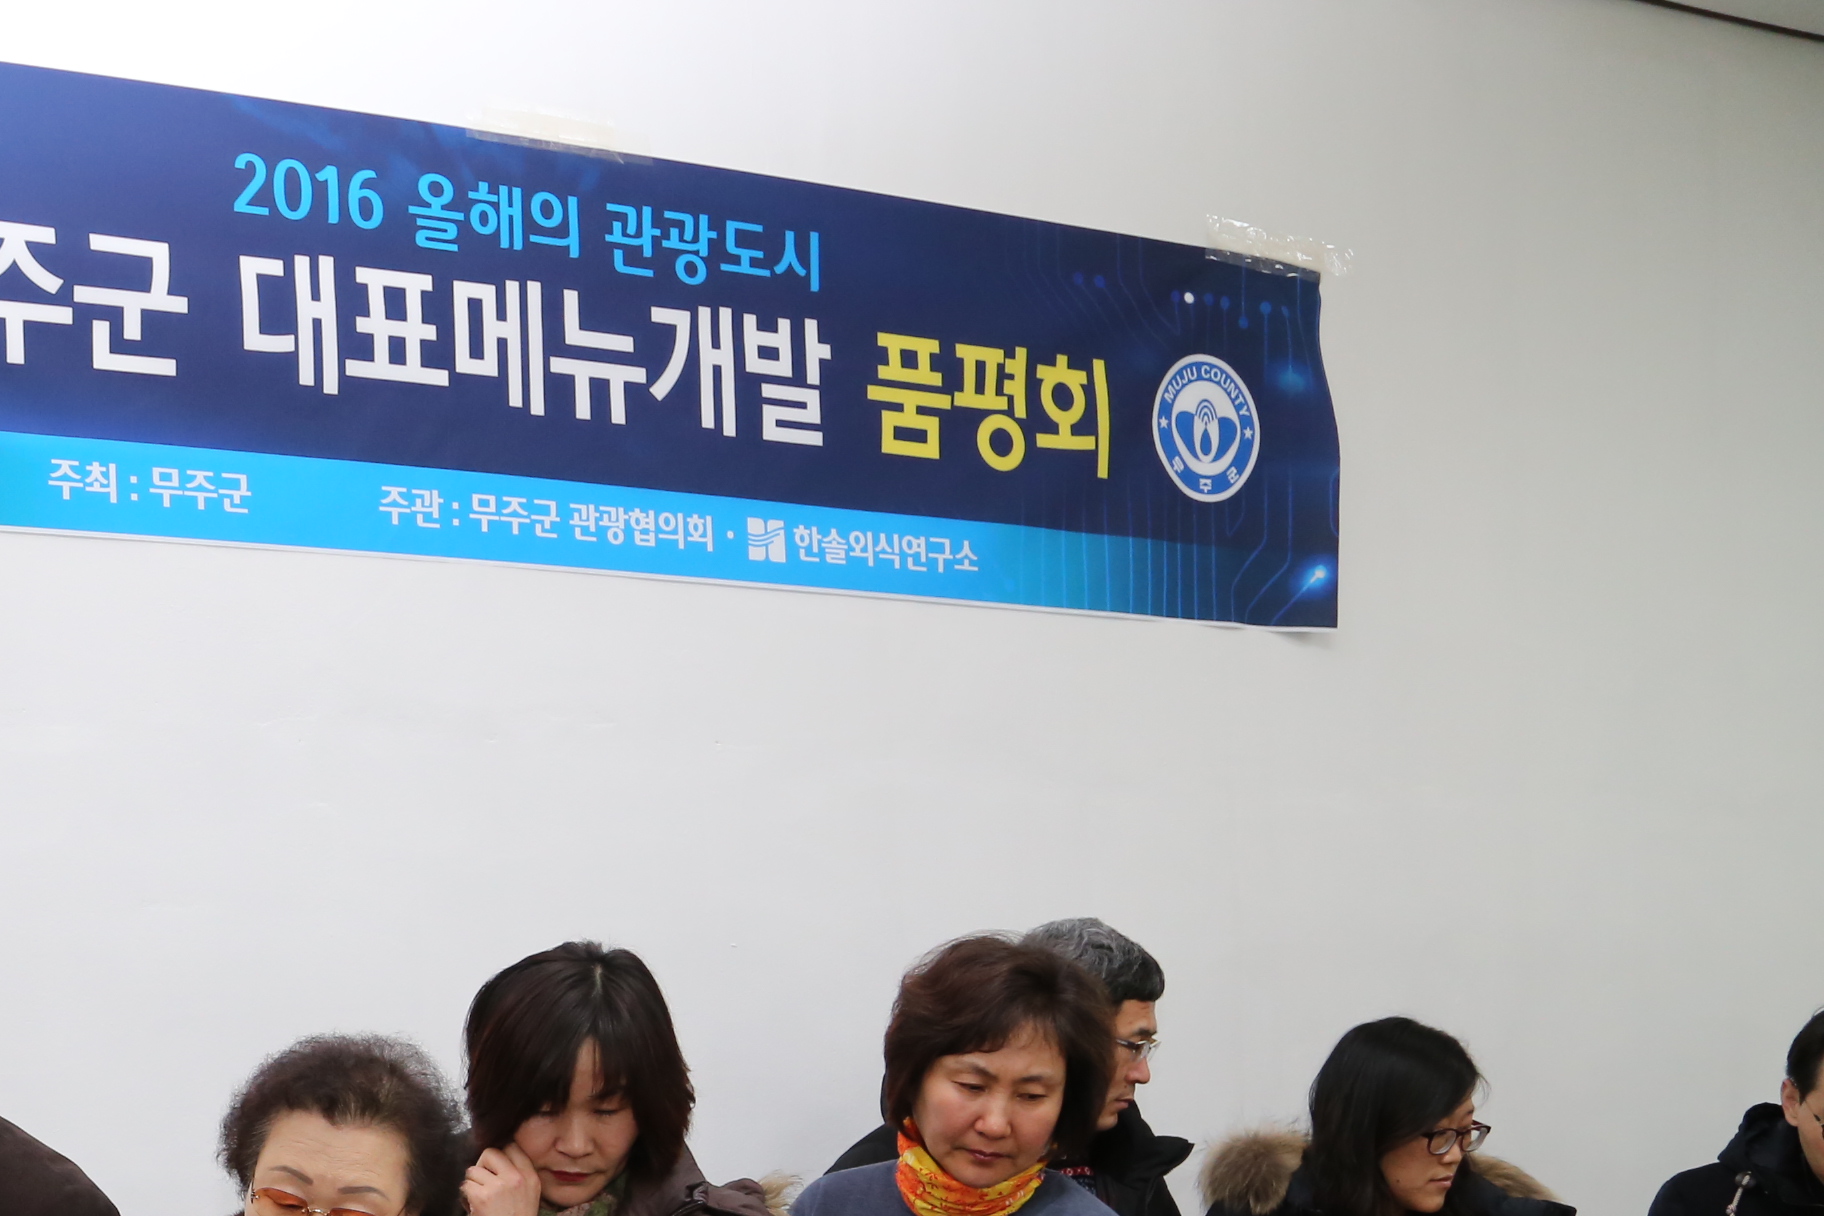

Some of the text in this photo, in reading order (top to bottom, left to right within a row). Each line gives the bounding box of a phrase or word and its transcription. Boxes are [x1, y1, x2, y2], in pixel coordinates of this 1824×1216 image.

[233, 152, 821, 292] 2016 올해의 관광도시
[239, 254, 832, 447] 대표메뉴개발
[866, 331, 1110, 480] 품평회
[1164, 365, 1251, 417] MUJU COUNTY
[48, 458, 118, 504] 주최
[149, 467, 252, 514] 무주군
[379, 485, 444, 529] 주관
[469, 493, 561, 539] 무주군
[569, 502, 714, 552] 관광협의회
[793, 525, 979, 573] 한솔외식연구소
